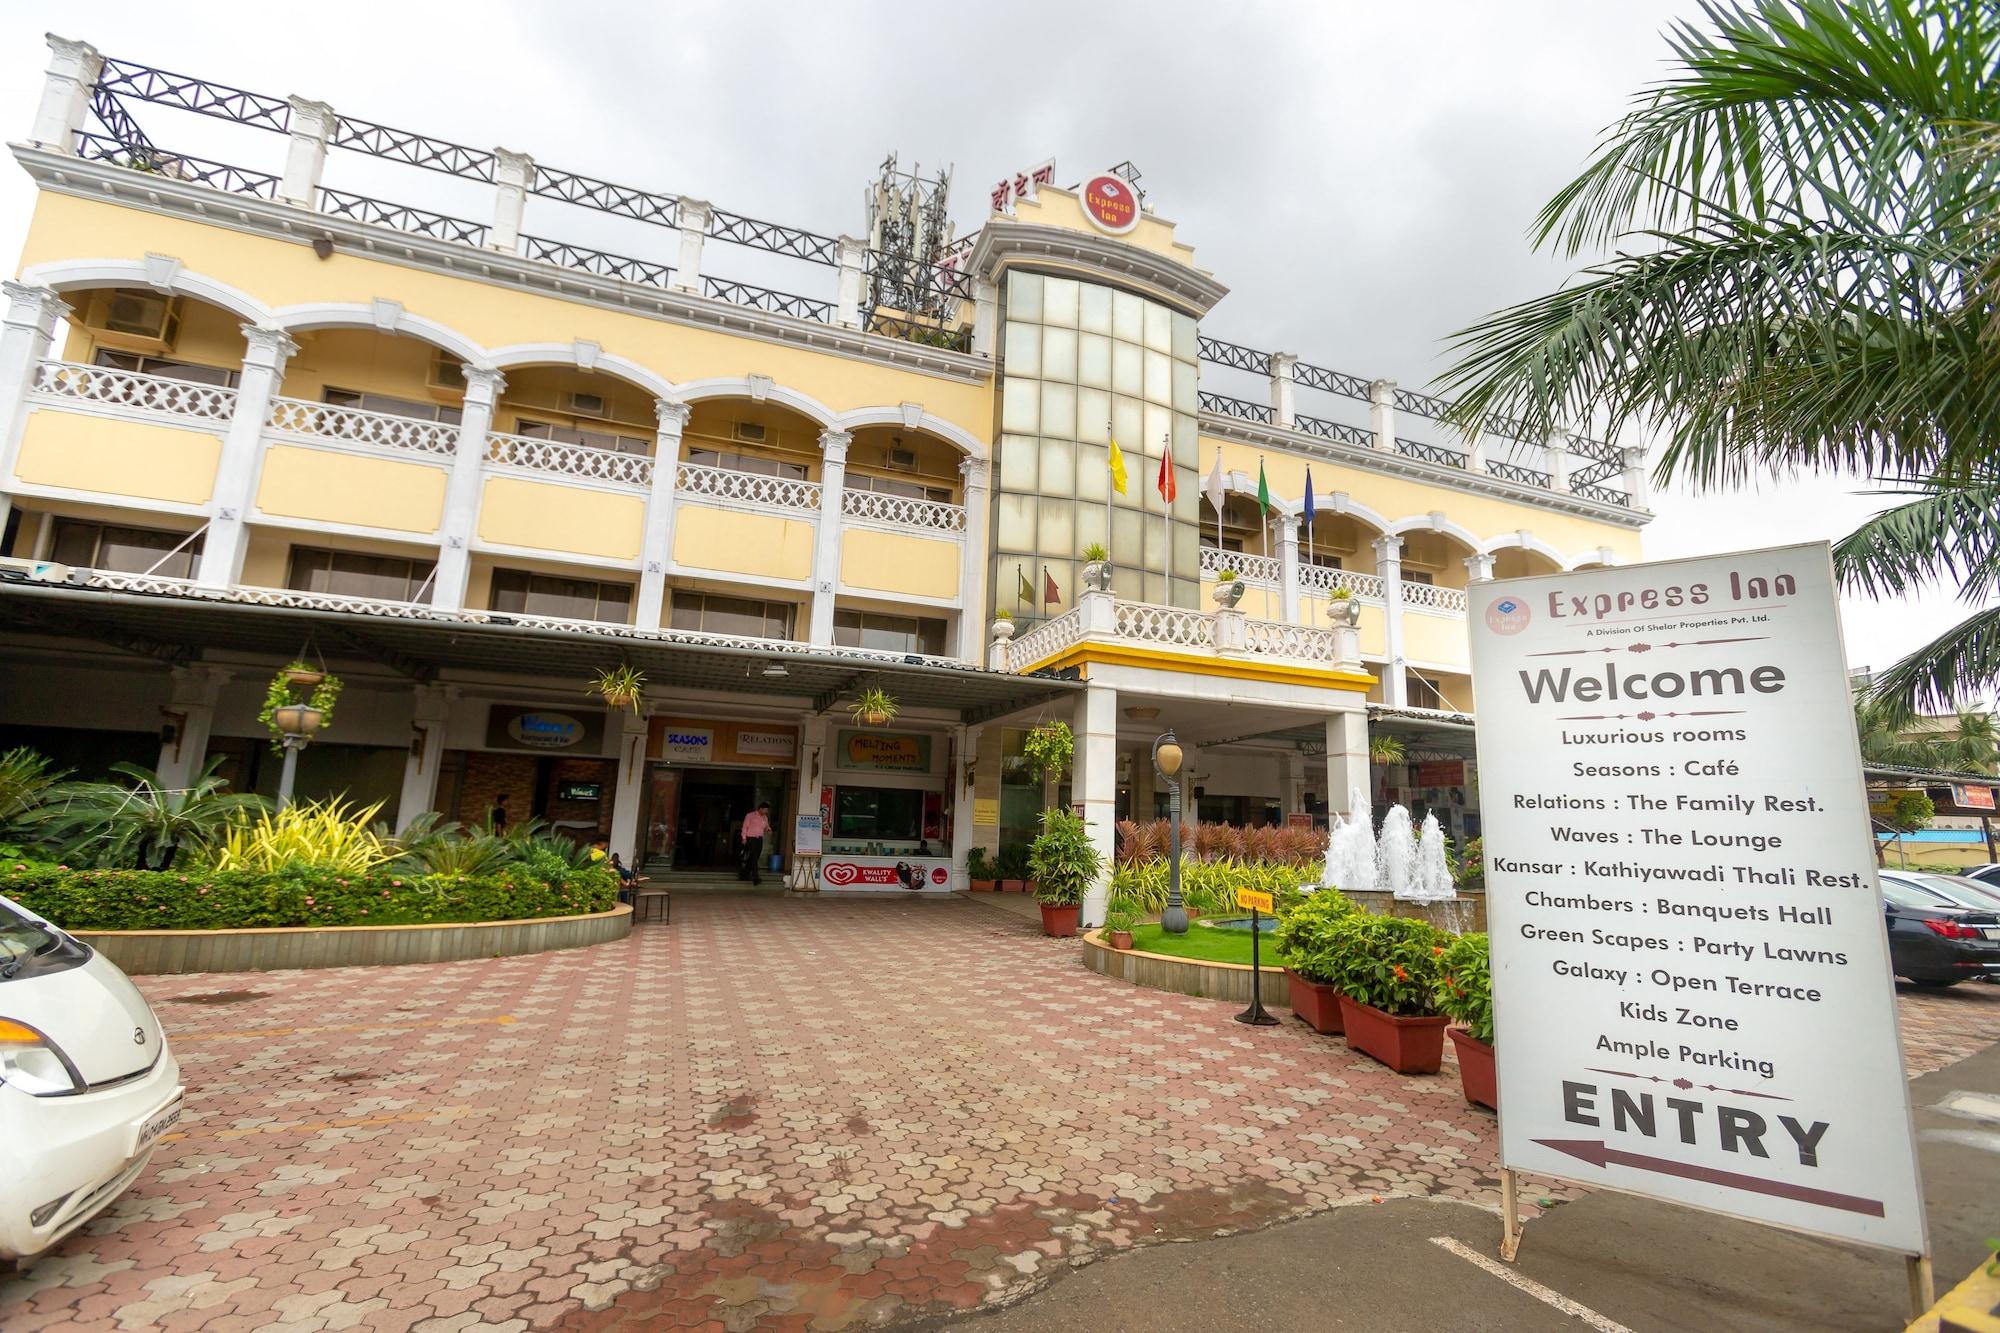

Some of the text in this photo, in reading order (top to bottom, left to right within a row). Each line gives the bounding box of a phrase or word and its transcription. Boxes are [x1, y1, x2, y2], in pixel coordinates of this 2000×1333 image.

[1088, 192, 1131, 213] Express
[1101, 208, 1117, 222] Inn
[1548, 571, 1797, 620] Express Inn
[1586, 614, 1770, 637] A Division Of Shelar Properties Pvt. Ltd.
[1518, 662, 1786, 704] Welcome
[668, 734, 708, 746] SEASONS
[855, 738, 901, 751] MELTING
[1562, 728, 1747, 745] Luxurious rooms
[1573, 762, 1661, 777] Seasons
[1684, 759, 1740, 776] Café
[1513, 793, 1606, 810] Relations
[1626, 794, 1668, 811] The
[1676, 794, 1755, 816] Family
[1764, 795, 1824, 812] Rest.
[1550, 826, 1619, 844] Waves
[1640, 828, 1683, 846] The
[1691, 829, 1782, 852] Lounge
[1493, 857, 1563, 875] Kansar
[1584, 860, 1725, 883] Kathiyawadi
[1732, 866, 1796, 886] Thali
[1805, 869, 1869, 889] Rest.
[1240, 894, 1270, 910] NO PARKING
[1525, 890, 1634, 913] Chambers
[1656, 898, 1770, 923] Banquets
[1778, 905, 1832, 926] Hall
[1520, 923, 1584, 943] Green
[1591, 928, 1669, 952] Scapes
[1693, 936, 1755, 962] Party
[1763, 942, 1848, 966] Lawns
[1552, 959, 1628, 986] Galaxy
[1651, 969, 1718, 992] Open
[1724, 975, 1822, 1002] Terrace
[1620, 1001, 1739, 1031] Kids Zone
[1595, 1034, 1775, 1079] Ample Parking
[1562, 1080, 1830, 1167] ENTRY
